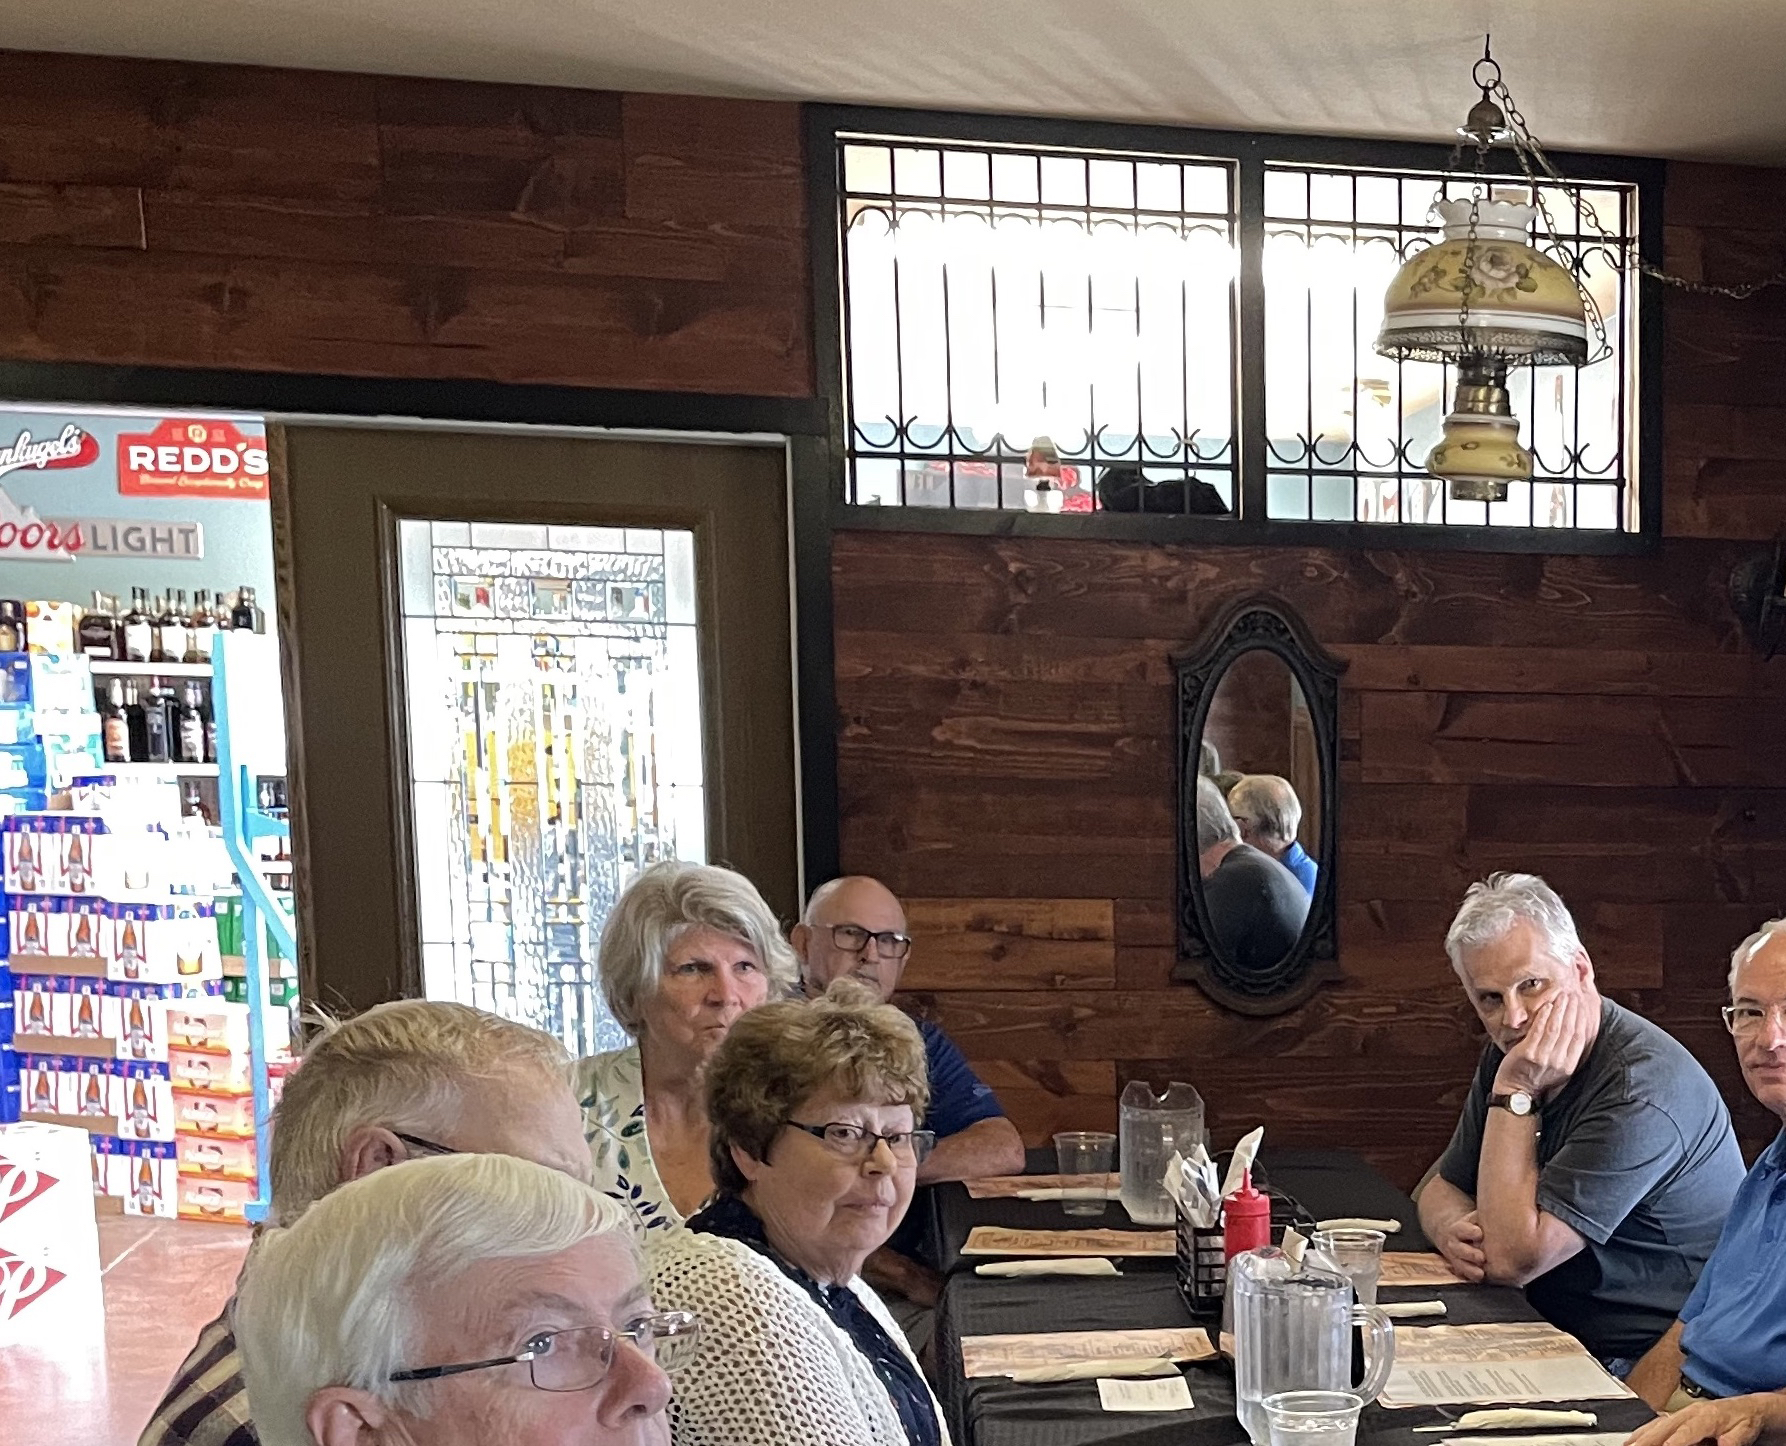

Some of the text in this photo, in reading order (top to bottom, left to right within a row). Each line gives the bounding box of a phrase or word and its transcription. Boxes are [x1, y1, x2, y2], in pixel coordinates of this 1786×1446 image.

[129, 442, 270, 476] REDD'S
[0, 521, 197, 554] oors LIGHT
